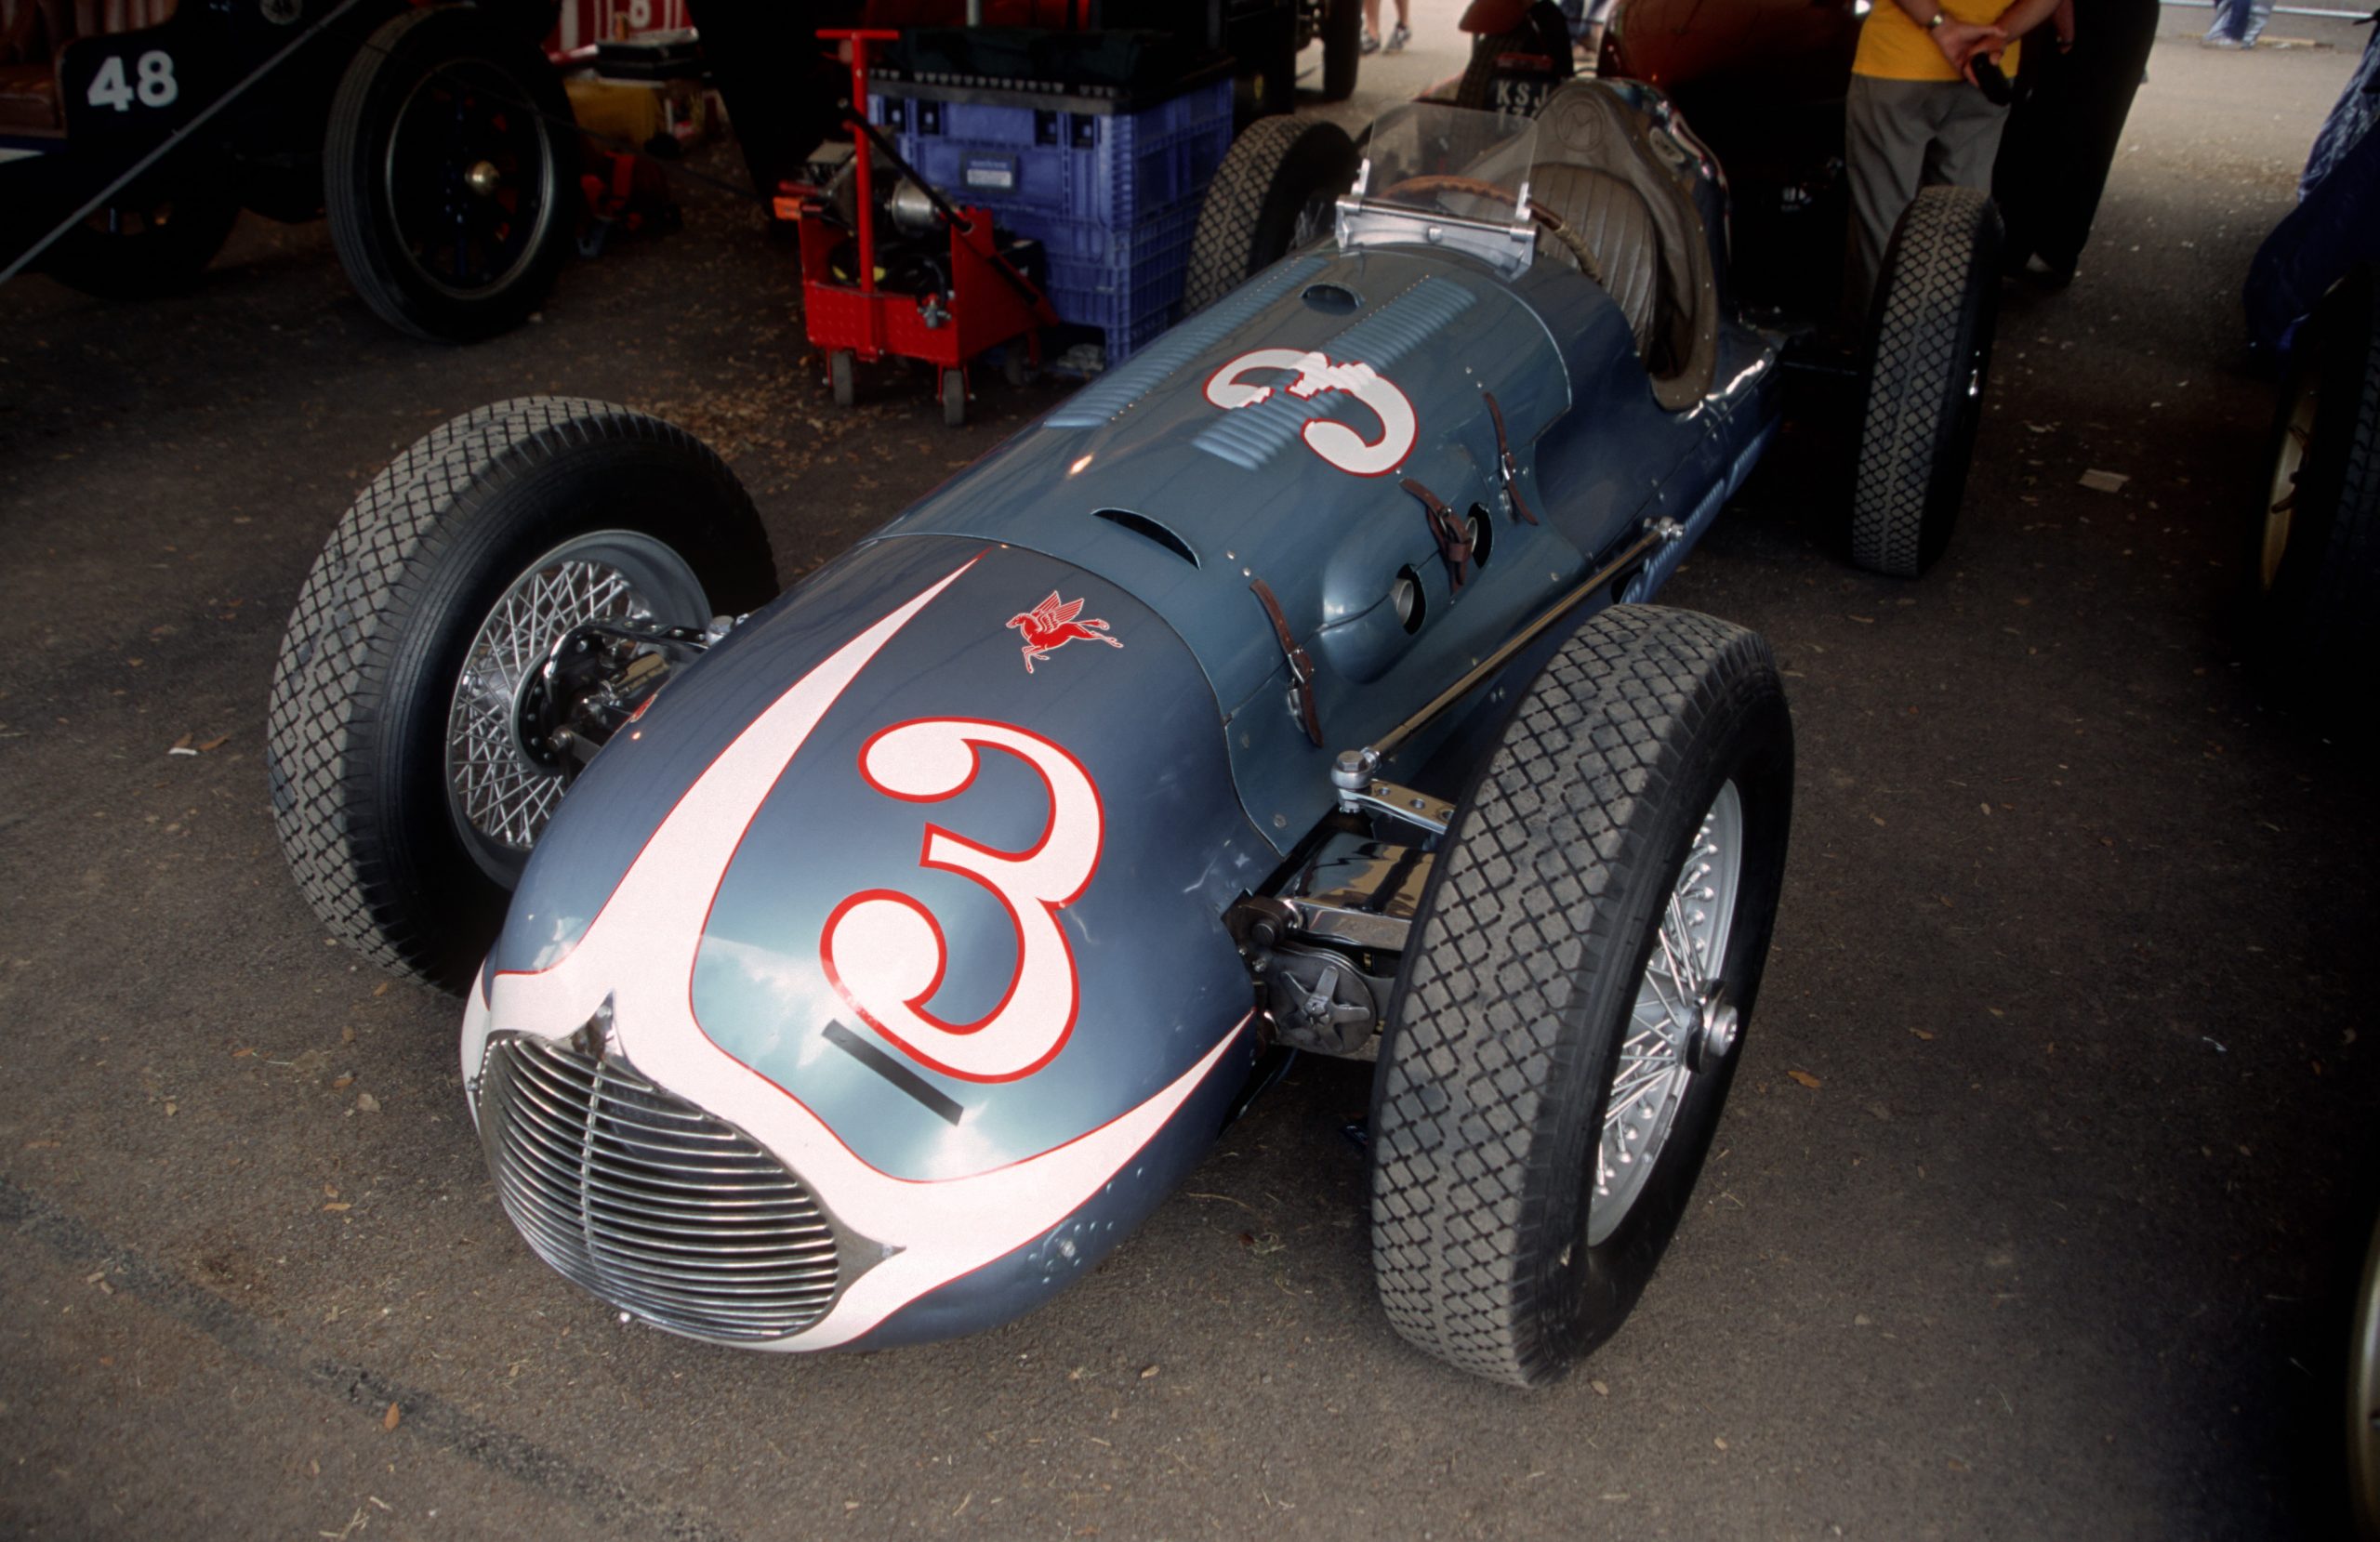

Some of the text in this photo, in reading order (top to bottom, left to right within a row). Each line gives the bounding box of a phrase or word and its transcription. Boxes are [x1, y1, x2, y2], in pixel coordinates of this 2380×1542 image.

[86, 50, 178, 112] 48
[1202, 348, 1419, 478] 3
[819, 716, 1105, 1084] 3
